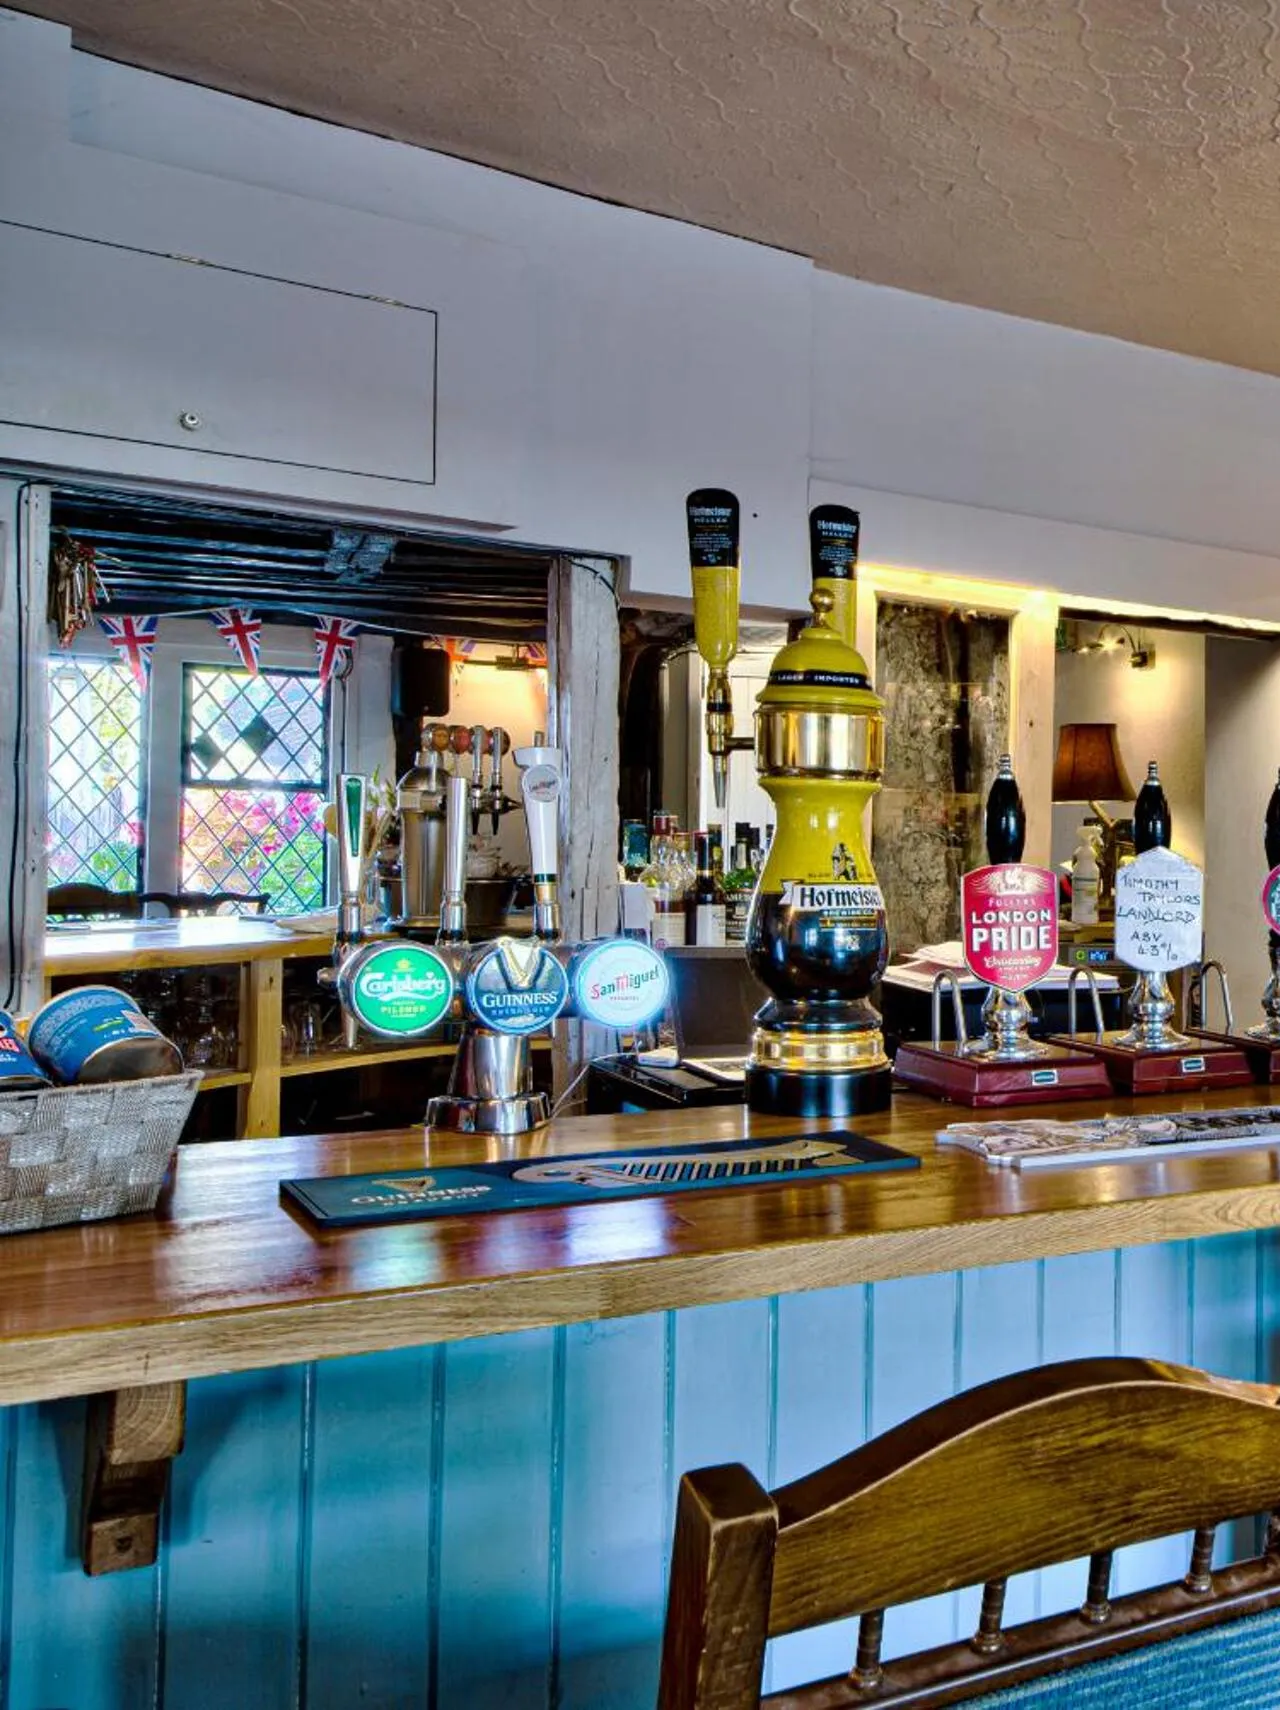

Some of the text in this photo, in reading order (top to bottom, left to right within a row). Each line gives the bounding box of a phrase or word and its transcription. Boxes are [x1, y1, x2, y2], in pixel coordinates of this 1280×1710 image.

[971, 909, 1051, 924] LONDON
[971, 926, 1052, 952] PRIDE
[1130, 930, 1162, 942] ABV
[360, 971, 446, 1002] Carlsberg
[482, 991, 558, 1008] GUINNESS
